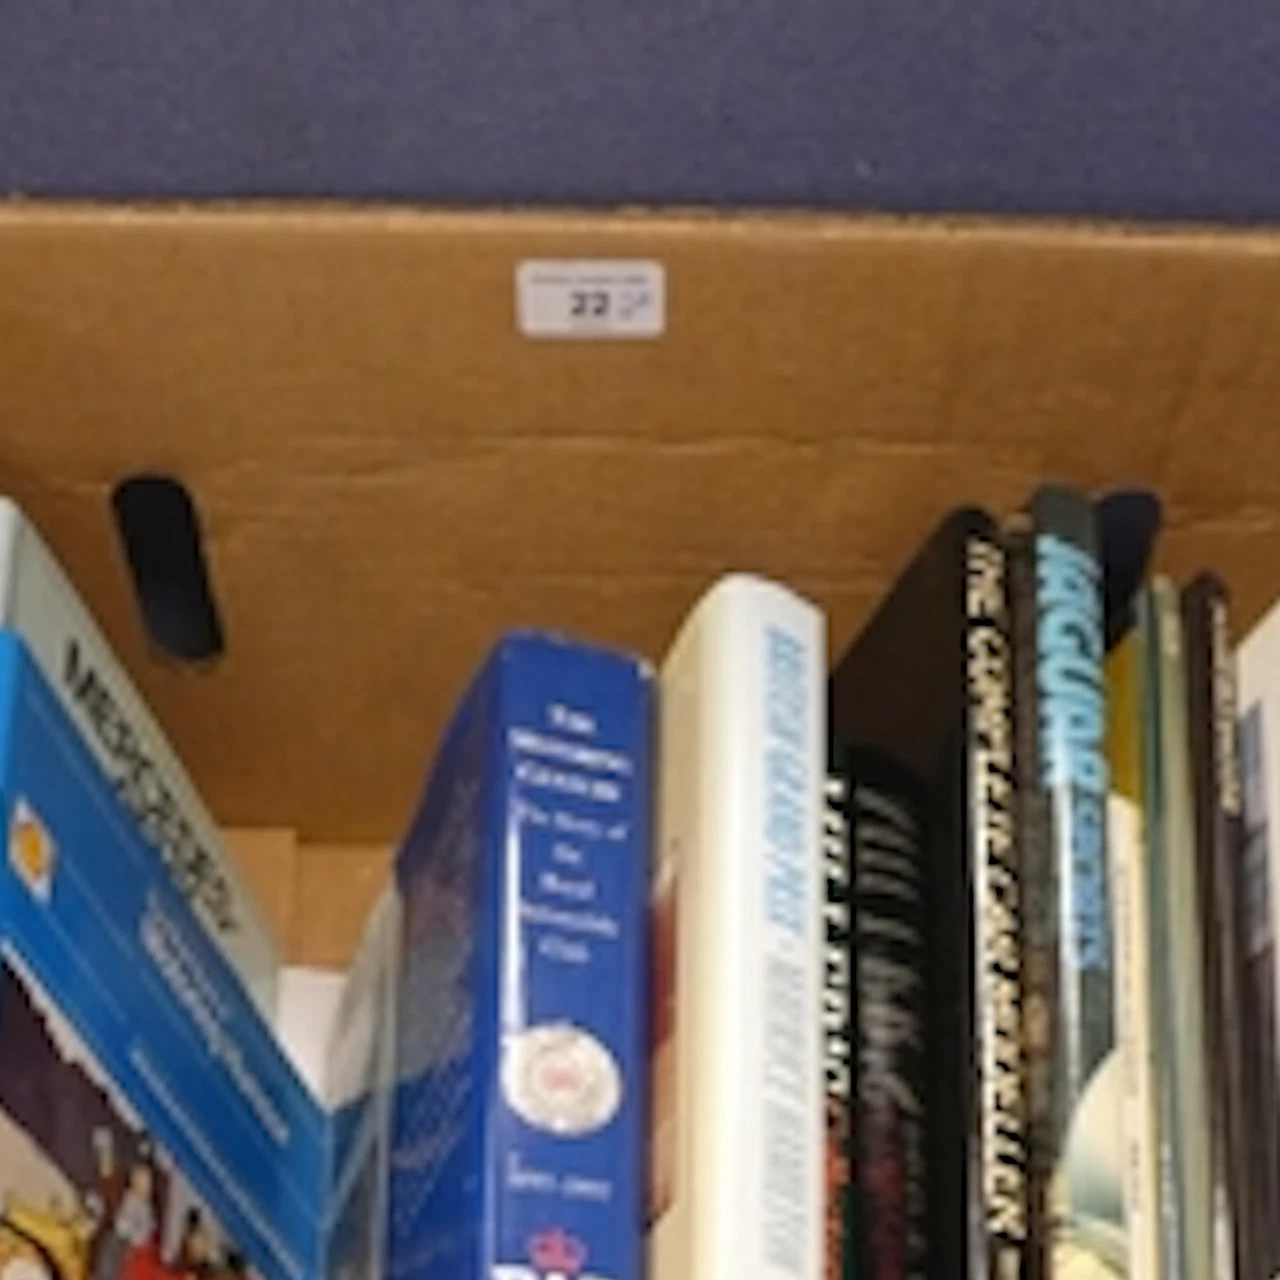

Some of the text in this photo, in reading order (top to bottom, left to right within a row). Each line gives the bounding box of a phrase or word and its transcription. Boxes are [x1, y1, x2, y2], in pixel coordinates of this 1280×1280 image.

[570, 290, 610, 318] 22
[964, 540, 1001, 613] THE
[1034, 534, 1108, 794] JAGUAR
